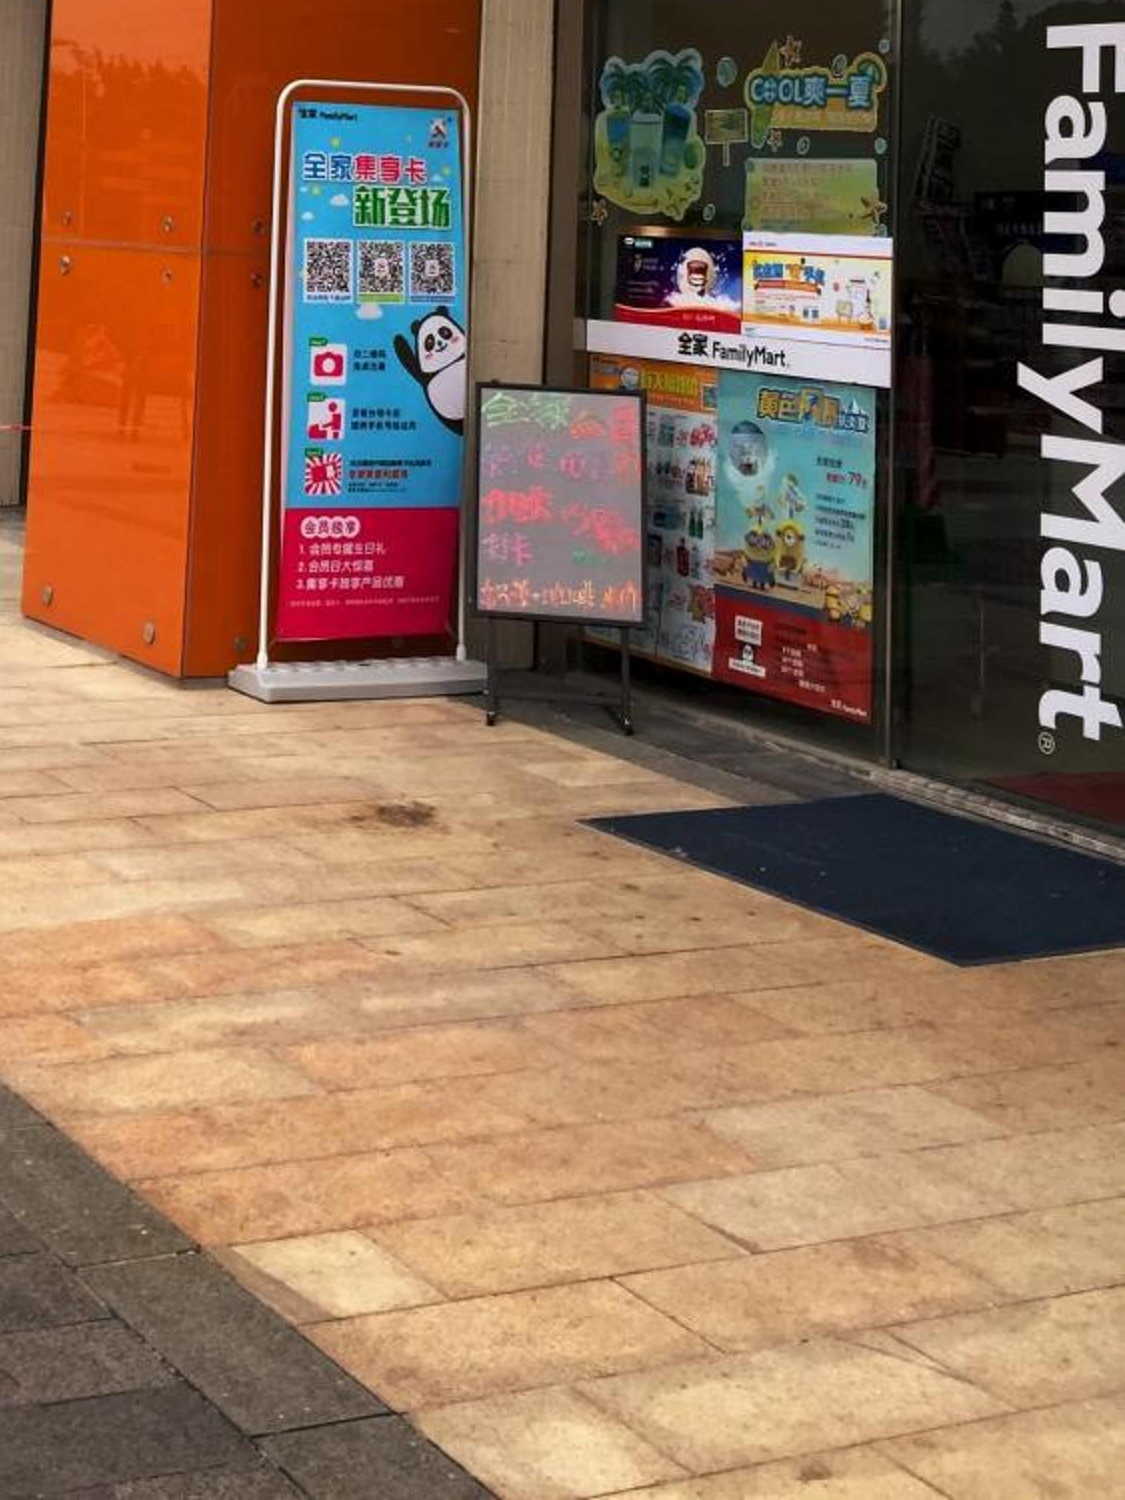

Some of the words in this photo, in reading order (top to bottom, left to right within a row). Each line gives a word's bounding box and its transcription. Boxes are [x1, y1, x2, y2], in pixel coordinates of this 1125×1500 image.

[304, 152, 427, 185] 全家集享卡
[354, 185, 451, 228] 新登场
[677, 331, 709, 357] 全家
[712, 341, 787, 367] FamilyMart
[1017, 24, 1125, 742] FamilyMart
